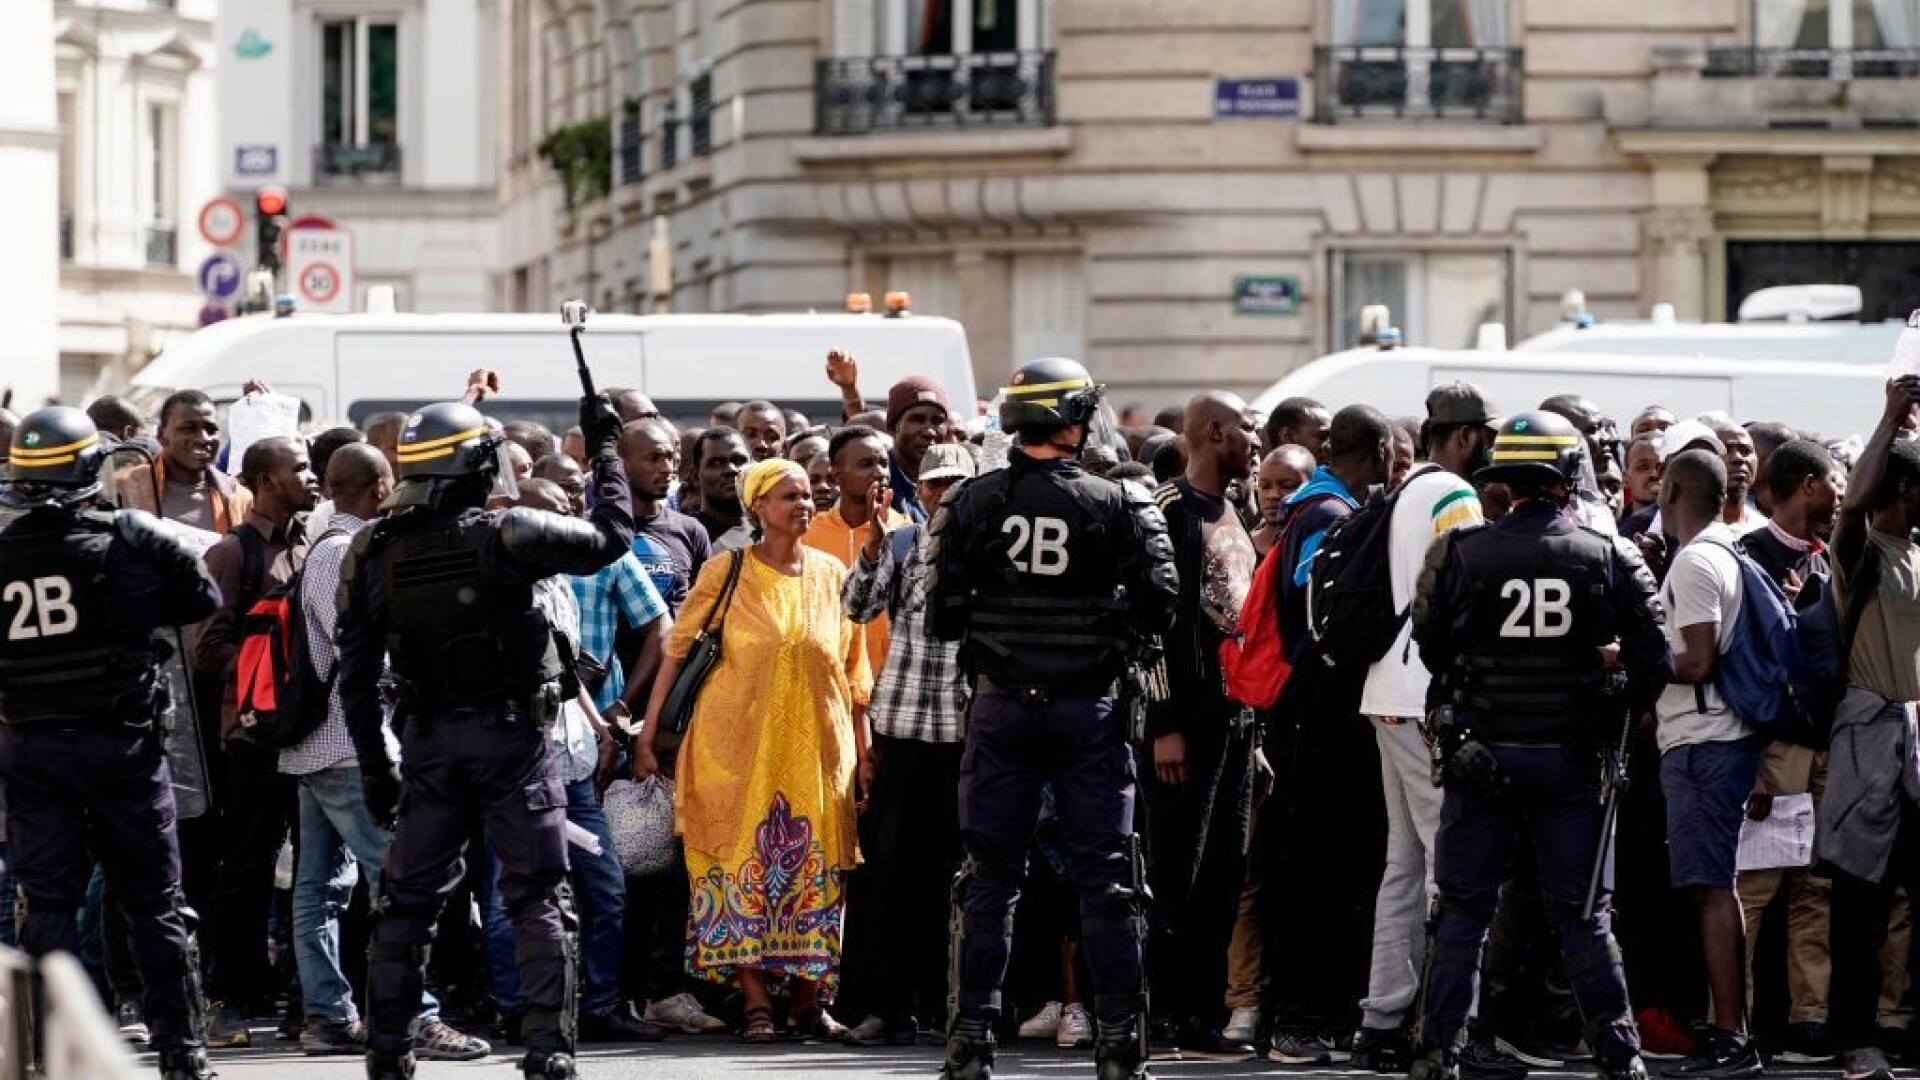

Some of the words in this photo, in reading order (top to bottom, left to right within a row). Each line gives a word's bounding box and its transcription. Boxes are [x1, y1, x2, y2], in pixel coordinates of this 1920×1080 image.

[1001, 514, 1069, 575] 2B
[3, 575, 78, 640] 2B
[1499, 578, 1572, 638] 2B
